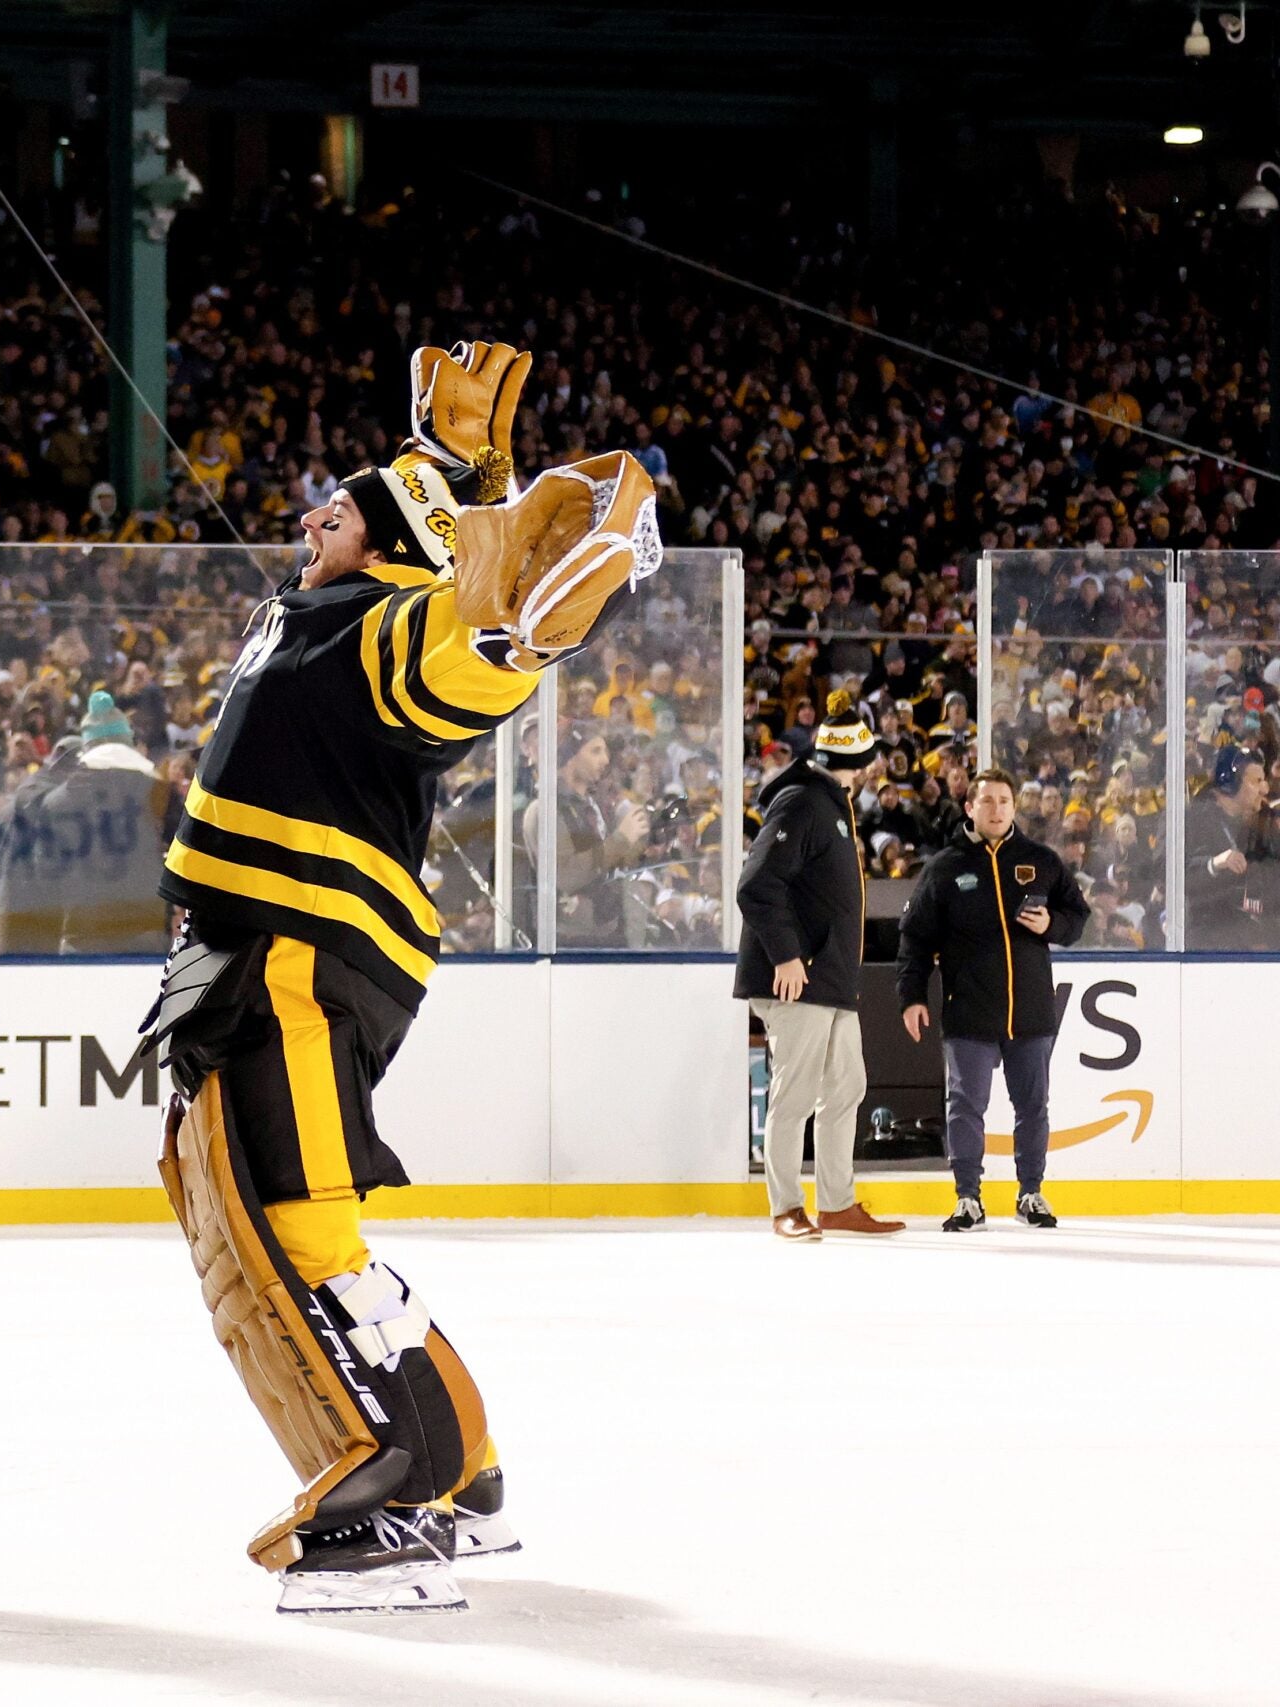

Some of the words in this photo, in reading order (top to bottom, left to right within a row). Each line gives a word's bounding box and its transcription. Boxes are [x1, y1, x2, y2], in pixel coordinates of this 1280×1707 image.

[383, 71, 409, 98] 14
[264, 1294, 351, 1438] TRUE
[308, 1292, 391, 1424] TRUE
